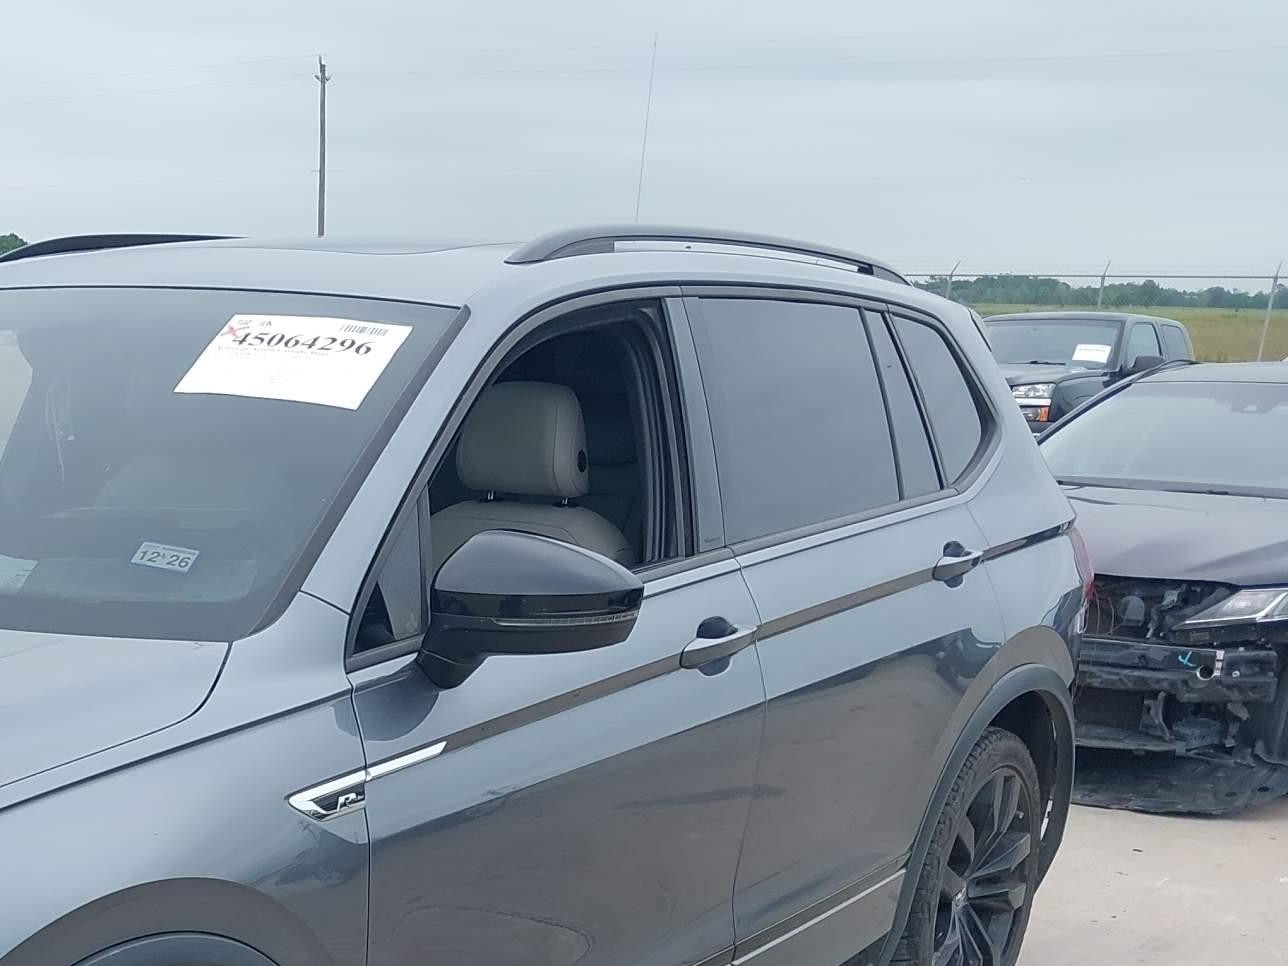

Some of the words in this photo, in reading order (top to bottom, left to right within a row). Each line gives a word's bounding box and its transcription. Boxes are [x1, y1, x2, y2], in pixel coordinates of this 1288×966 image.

[231, 332, 376, 356] 45064296
[139, 550, 161, 563] 12
[165, 554, 192, 568] 26
